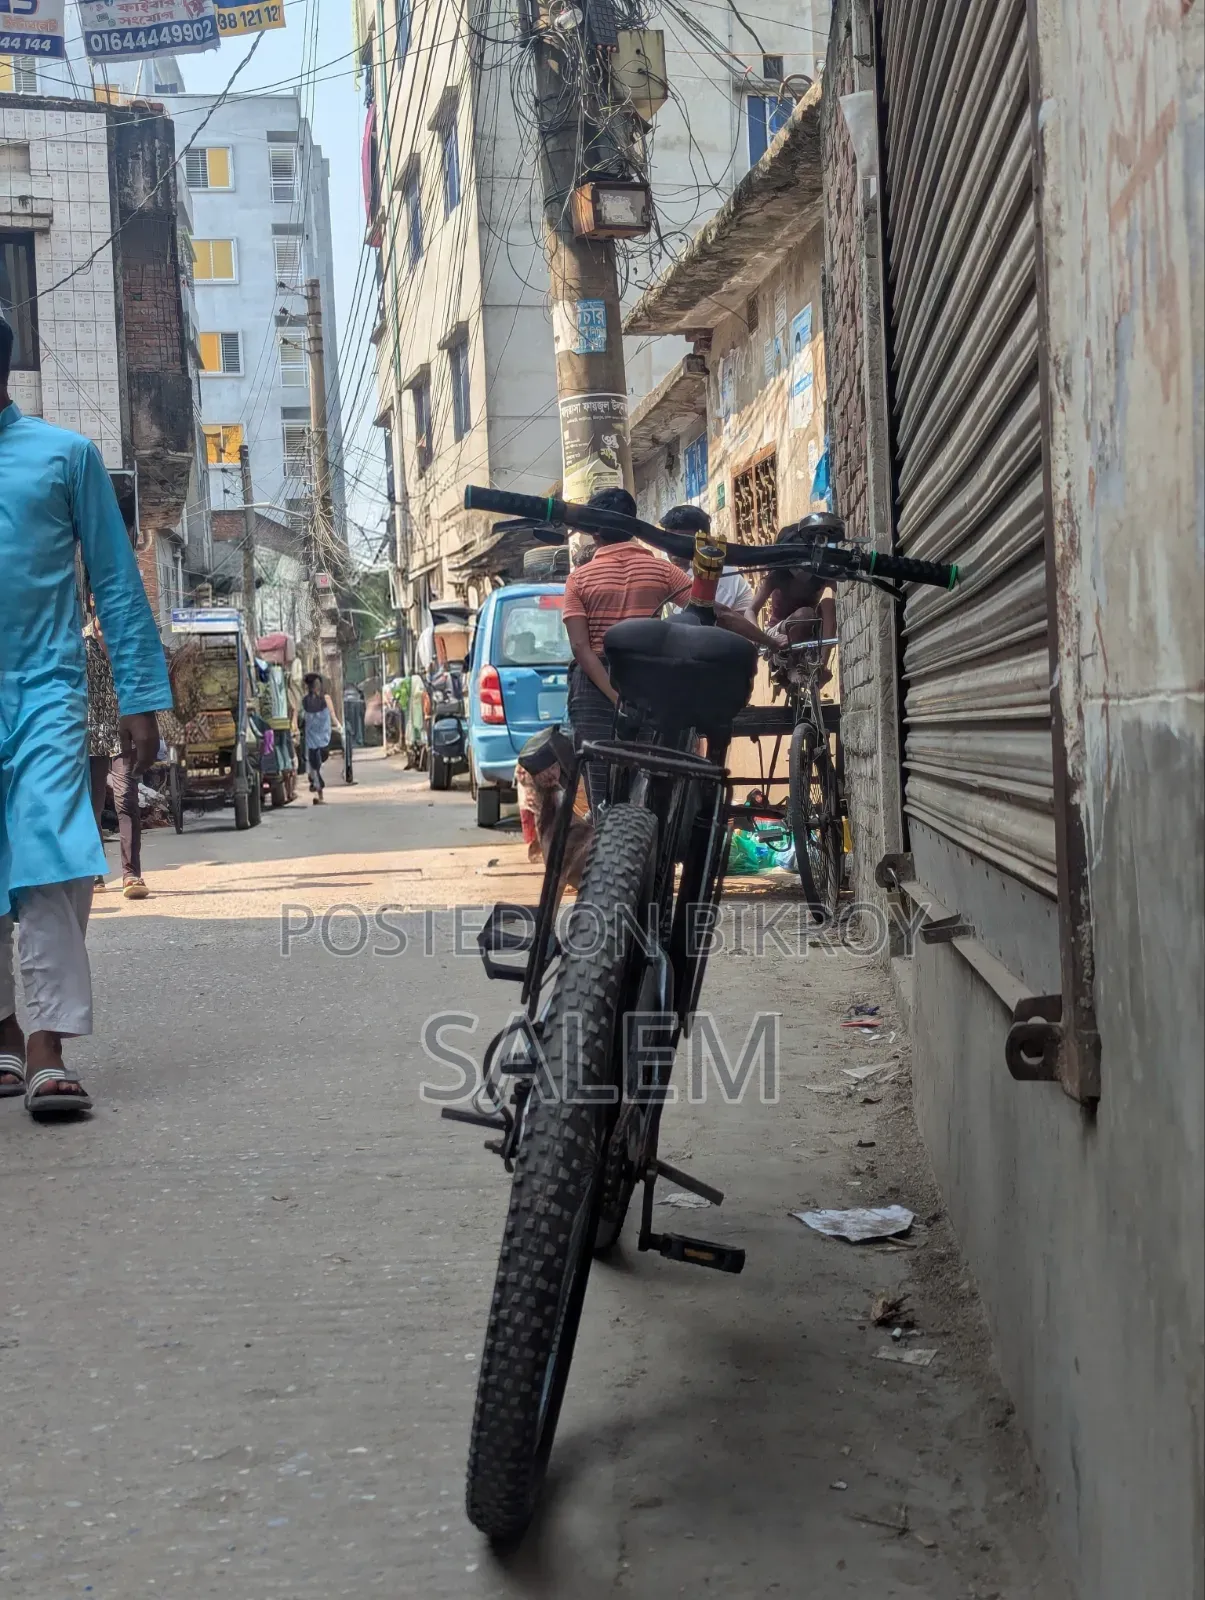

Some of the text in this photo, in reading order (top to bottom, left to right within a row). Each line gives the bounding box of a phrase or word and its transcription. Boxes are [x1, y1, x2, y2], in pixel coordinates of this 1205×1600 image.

[240, 9, 262, 28] 121
[24, 37, 52, 52] 144
[90, 19, 214, 52] 01644449902
